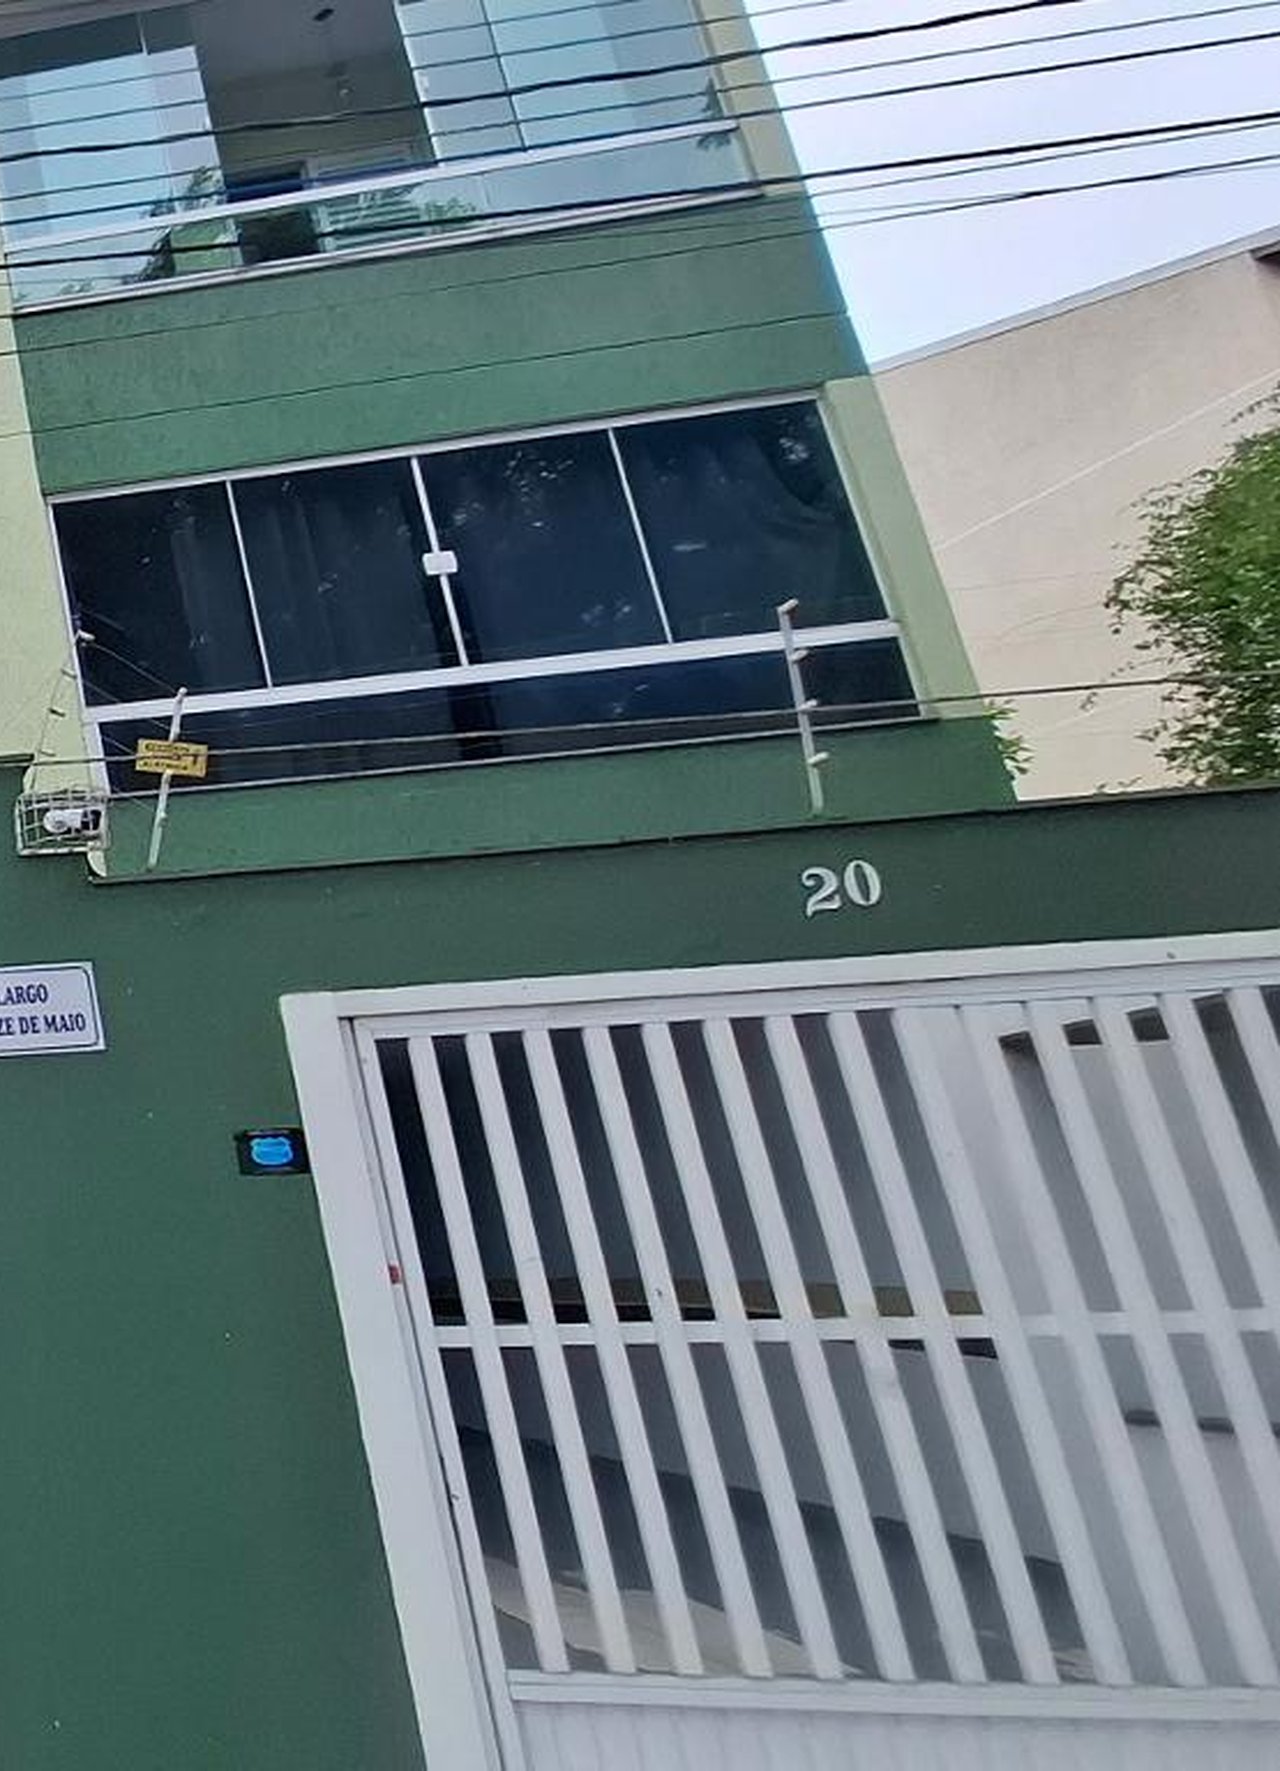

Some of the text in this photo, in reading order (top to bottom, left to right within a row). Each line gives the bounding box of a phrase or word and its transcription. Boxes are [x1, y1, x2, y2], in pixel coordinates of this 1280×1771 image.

[801, 860, 881, 917] 20
[19, 1015, 40, 1035] DE
[43, 1013, 87, 1033] MAIO
